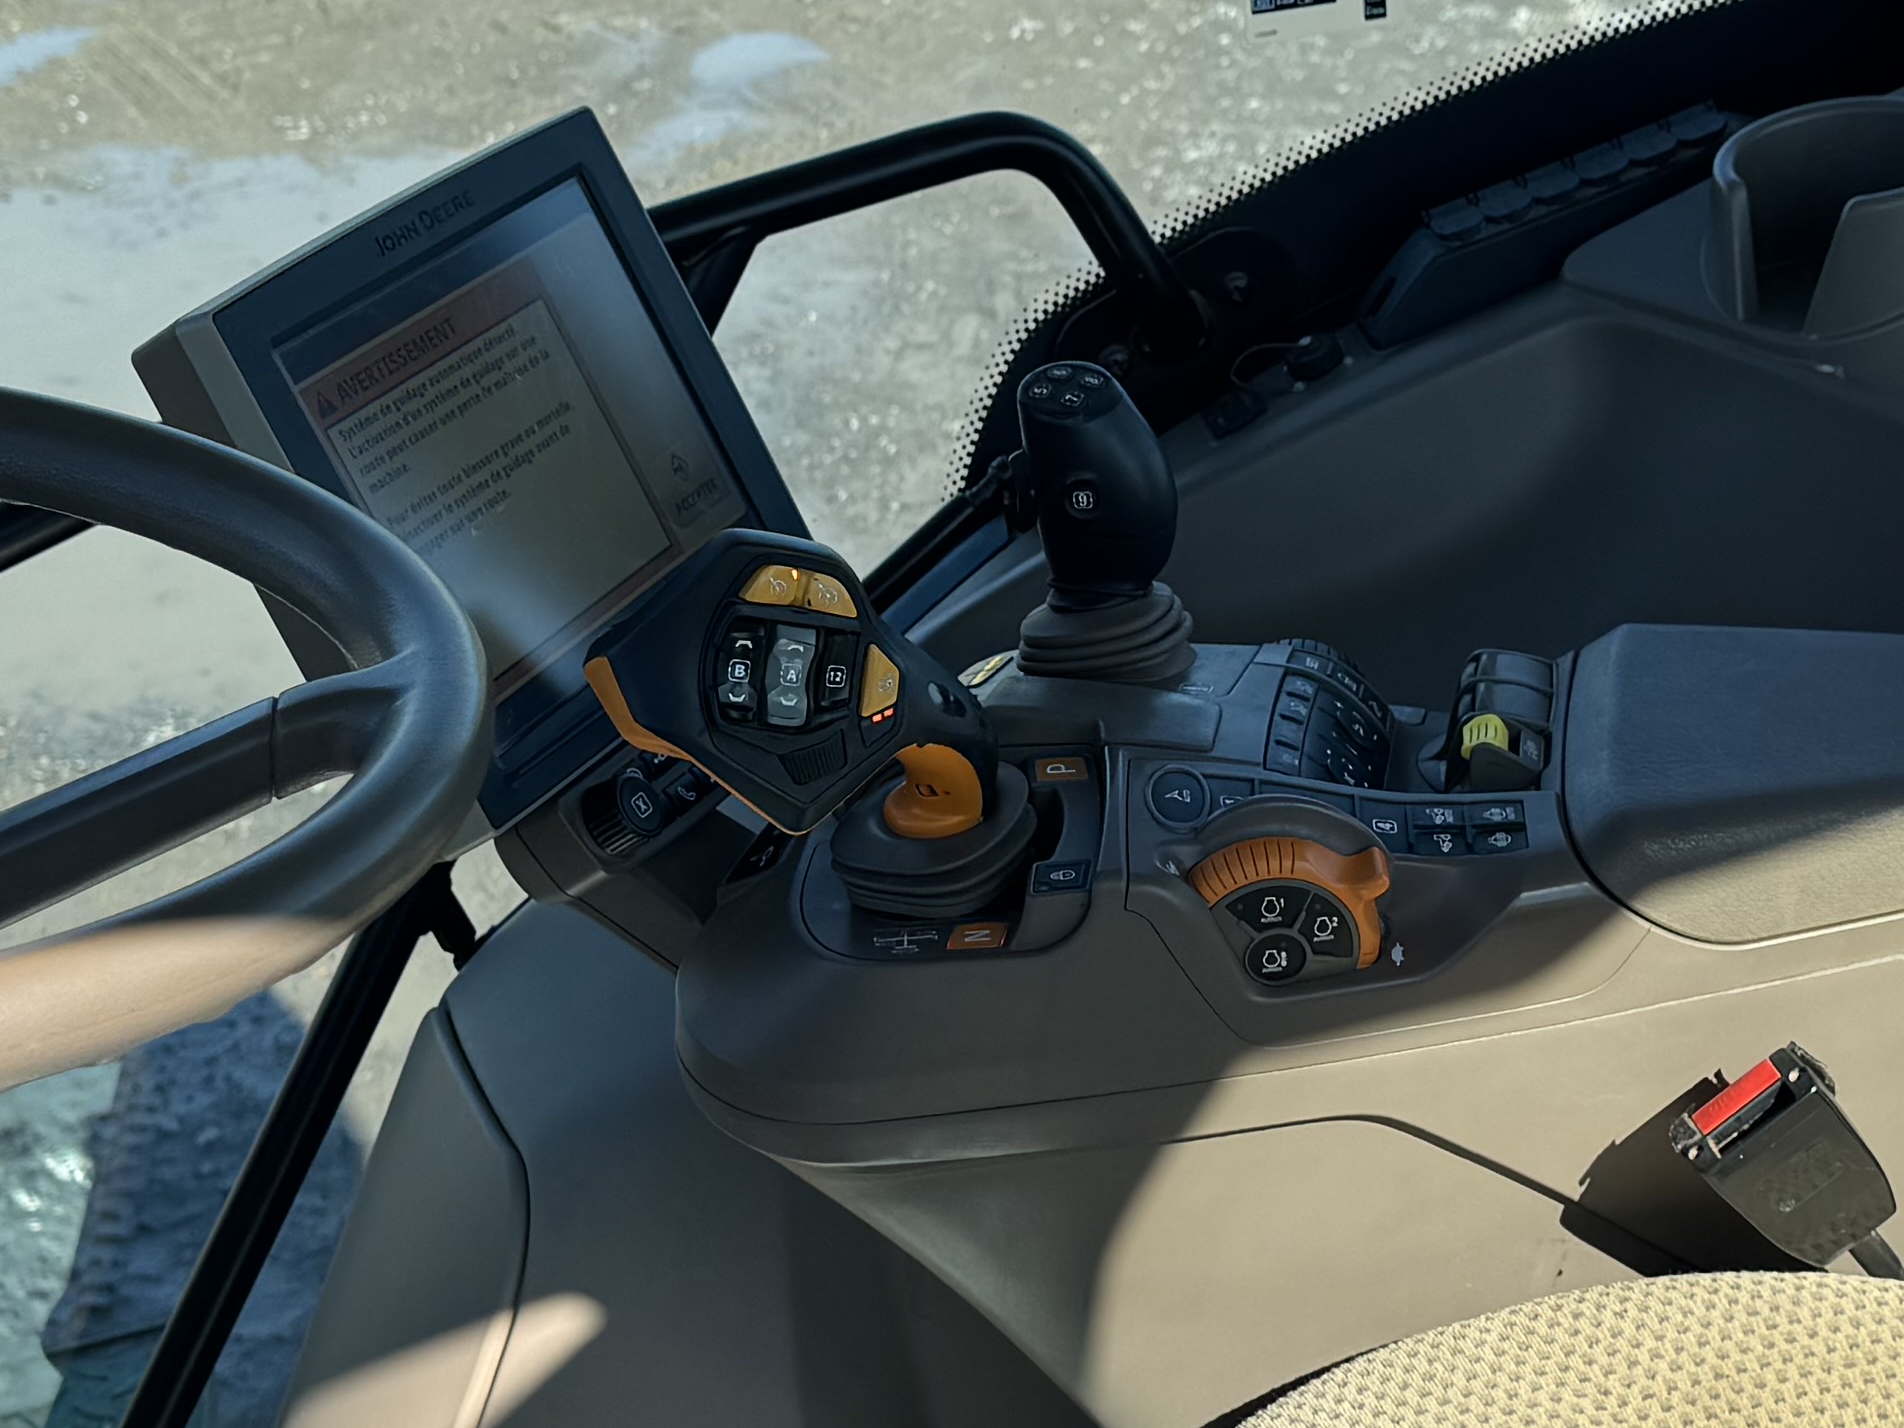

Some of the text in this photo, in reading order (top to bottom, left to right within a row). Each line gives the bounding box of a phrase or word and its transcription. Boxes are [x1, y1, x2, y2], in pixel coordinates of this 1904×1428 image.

[375, 190, 476, 257] JOHN DEERE
[336, 317, 457, 404] AVERTISSEMENT
[379, 404, 392, 417] de
[735, 664, 746, 677] B
[786, 669, 797, 682] A
[830, 671, 842, 682] 12
[1047, 764, 1076, 774] P
[964, 929, 991, 942] N
